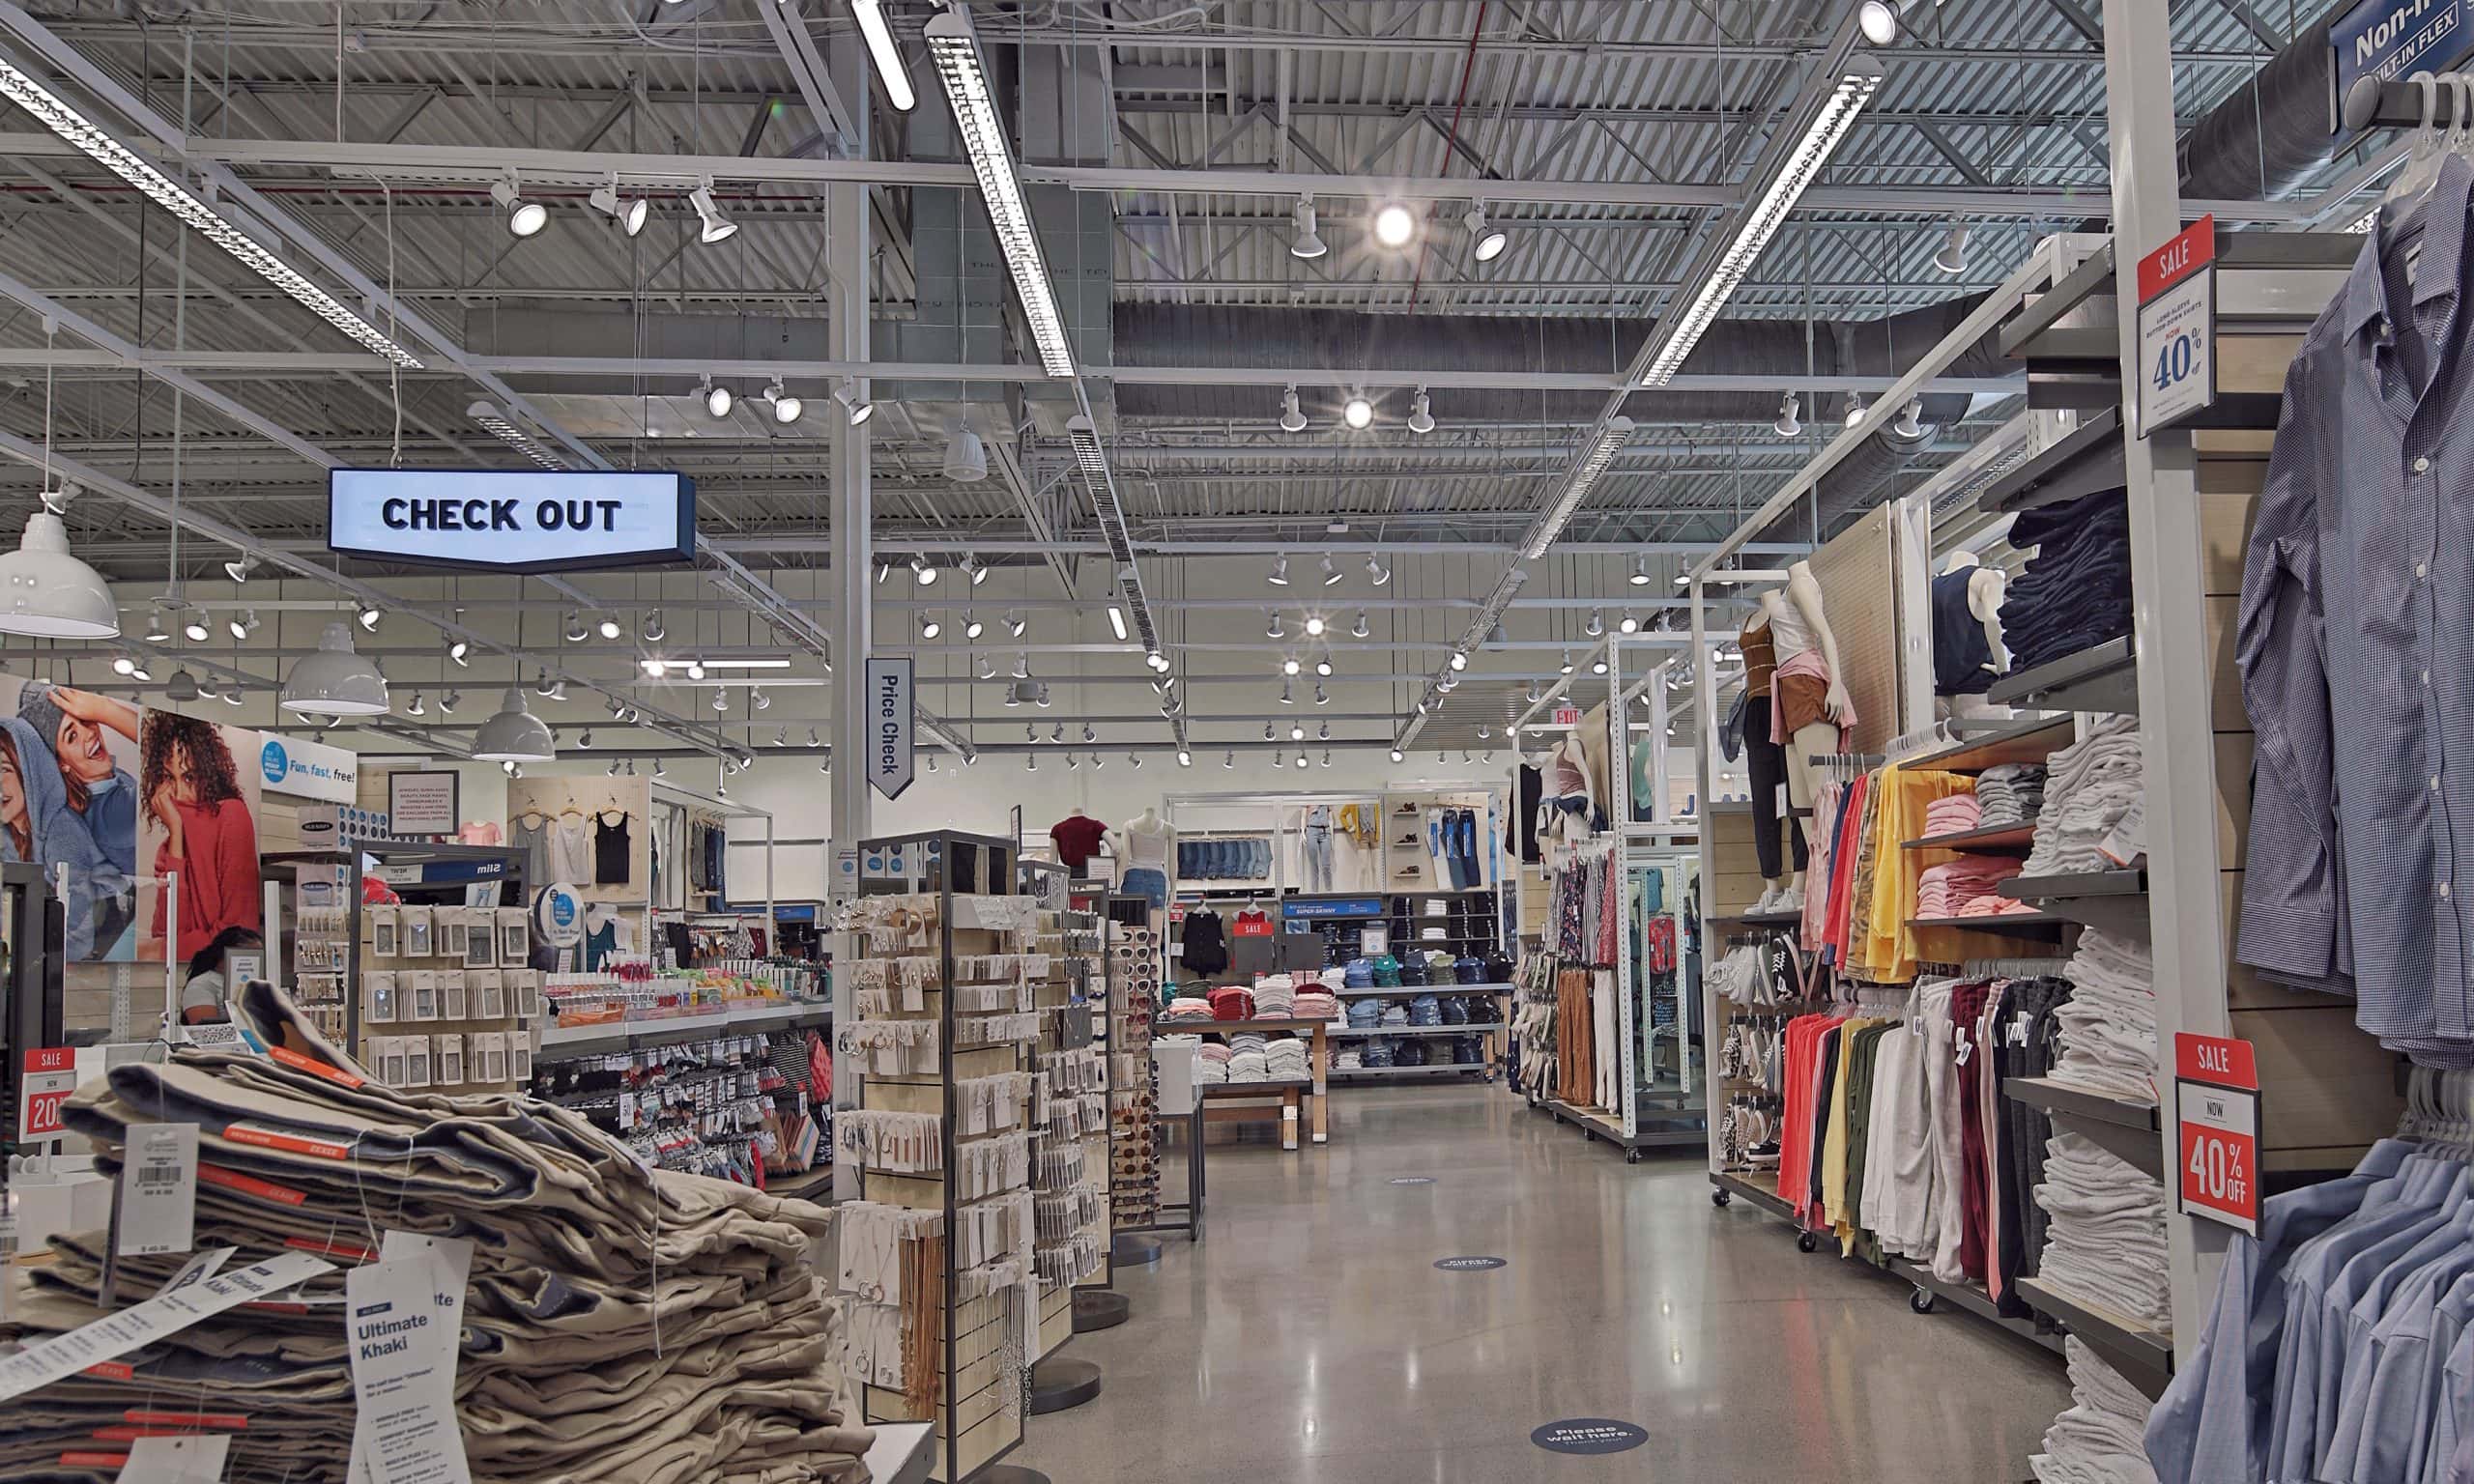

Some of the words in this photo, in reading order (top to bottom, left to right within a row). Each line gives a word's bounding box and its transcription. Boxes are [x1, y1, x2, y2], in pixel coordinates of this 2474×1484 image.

[2419, 10, 2454, 50] FLEX
[2159, 239, 2189, 279] SALE
[2165, 327, 2180, 341] NOW
[382, 498, 521, 531] CHECK
[536, 499, 622, 531] OUT
[881, 674, 898, 718] Price
[1557, 710, 1577, 724] EXIT
[881, 722, 899, 775] Check
[290, 759, 309, 776] Fun,
[310, 763, 331, 780] fast,
[333, 768, 355, 783] free!
[1245, 925, 1262, 933] SALE
[41, 1052, 61, 1067] SALE
[2197, 1044, 2229, 1073] SALE
[2206, 1100, 2224, 1117] NOW
[2228, 1179, 2246, 1205] OFF
[358, 1314, 428, 1340] Ultimate
[360, 1335, 408, 1360] Khaki
[1546, 1434, 1585, 1442] wait
[1555, 1426, 1617, 1436] Please
